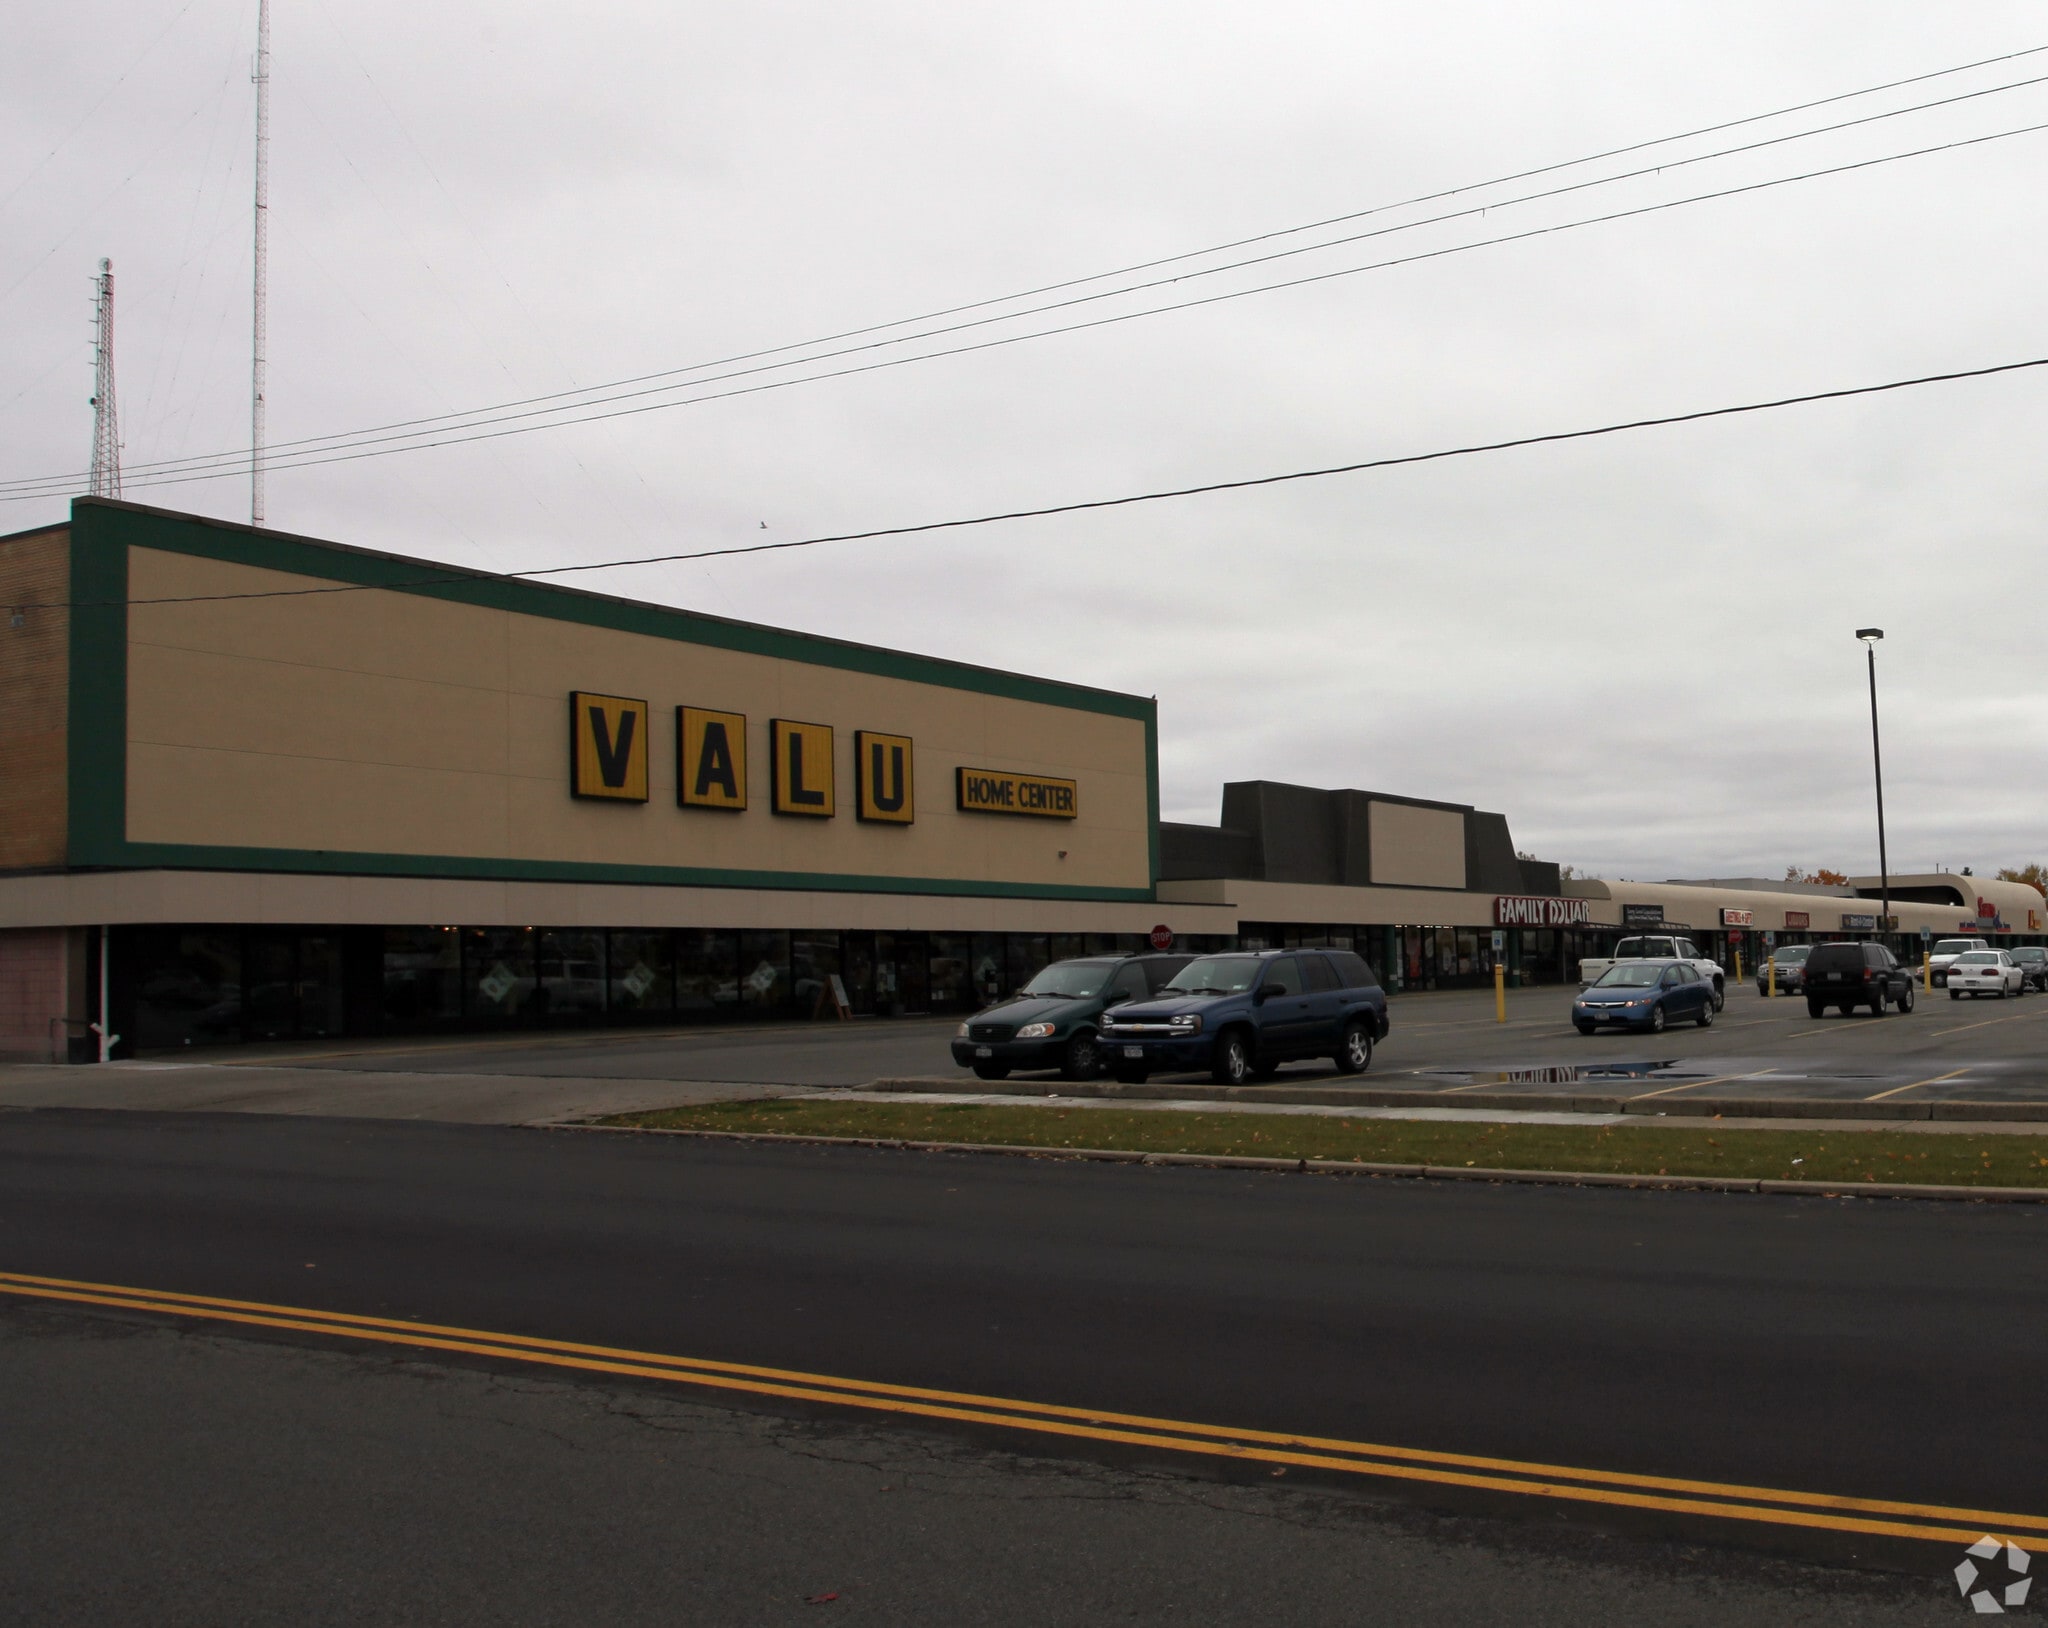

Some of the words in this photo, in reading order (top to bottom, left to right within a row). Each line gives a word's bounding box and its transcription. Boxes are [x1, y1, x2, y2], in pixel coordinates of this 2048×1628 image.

[588, 706, 905, 812] VALU
[967, 776, 1014, 807] HOME
[1018, 781, 1074, 812] CENTER
[1498, 897, 1545, 924] FAMILY
[1549, 899, 1590, 925] DOLLAR
[1152, 931, 1170, 943] STOP
